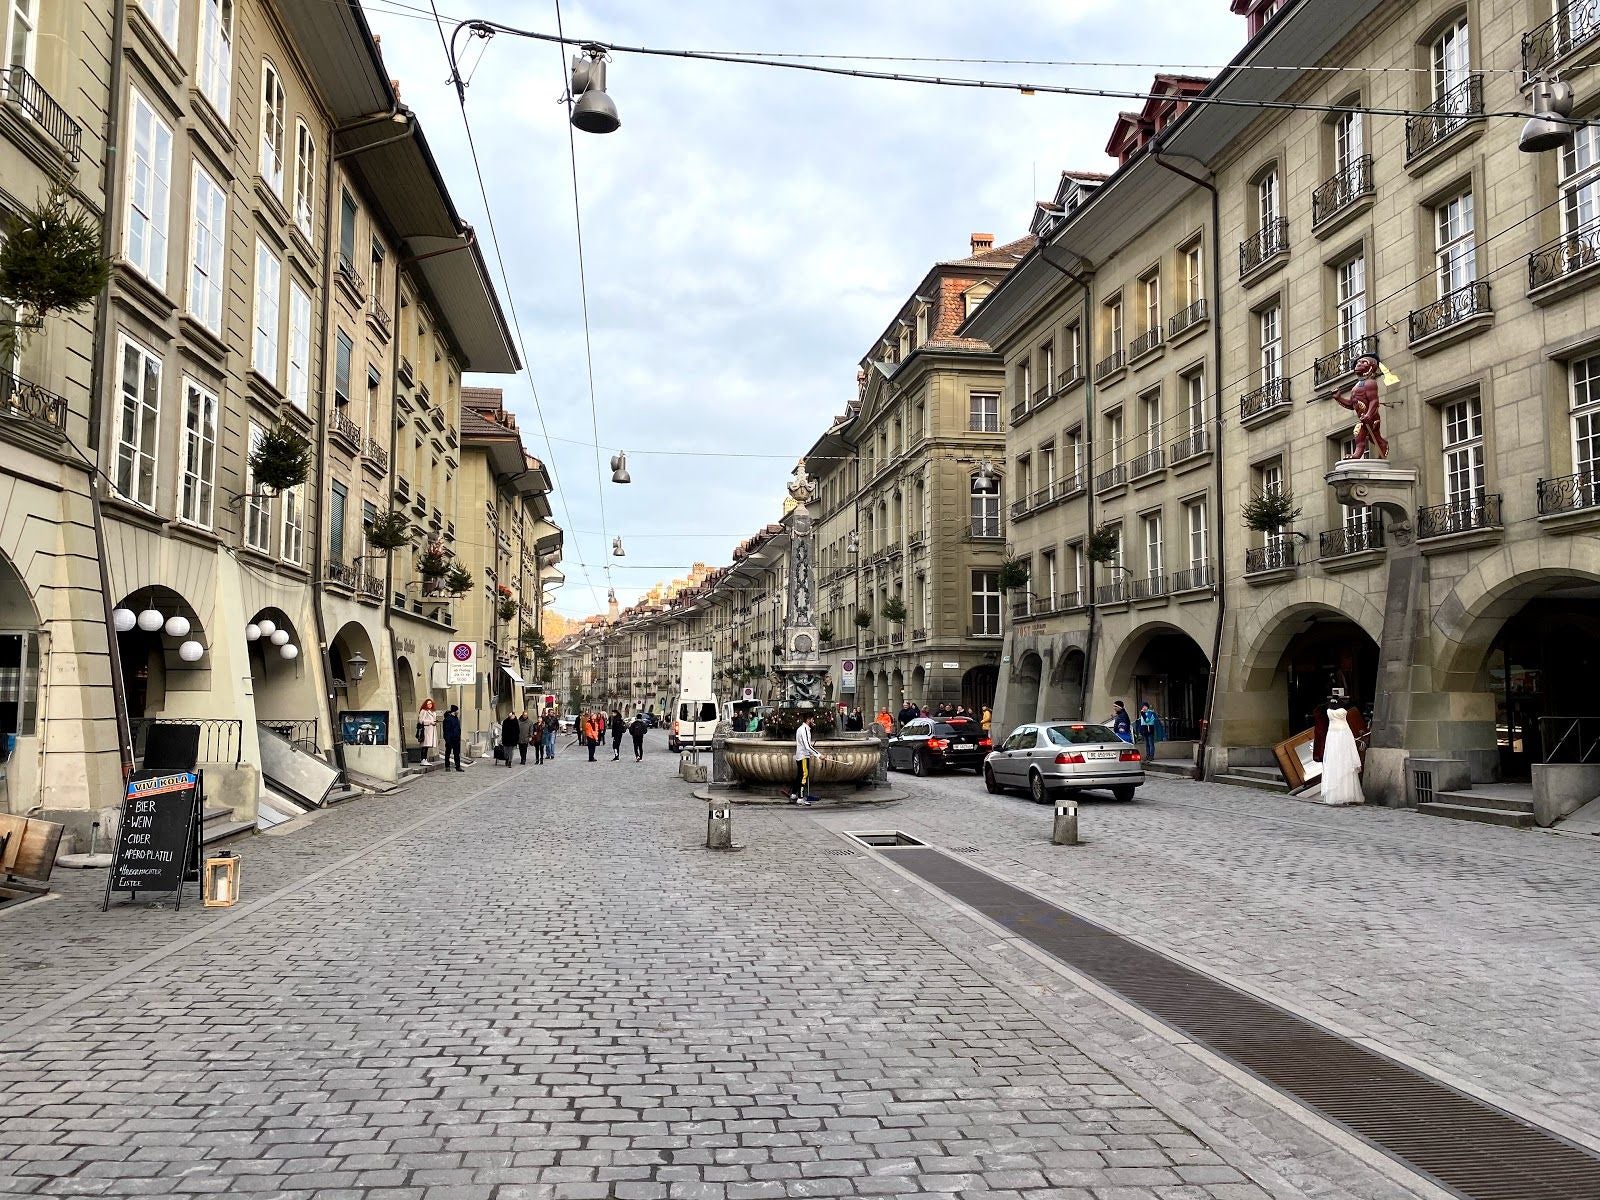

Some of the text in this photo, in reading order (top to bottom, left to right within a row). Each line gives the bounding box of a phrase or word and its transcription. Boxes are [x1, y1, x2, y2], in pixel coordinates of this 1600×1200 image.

[134, 781, 157, 791] VIVI
[160, 775, 188, 788] KOLA
[135, 800, 157, 813] BIER
[131, 815, 153, 828] WEIN
[127, 833, 151, 845] CIDER
